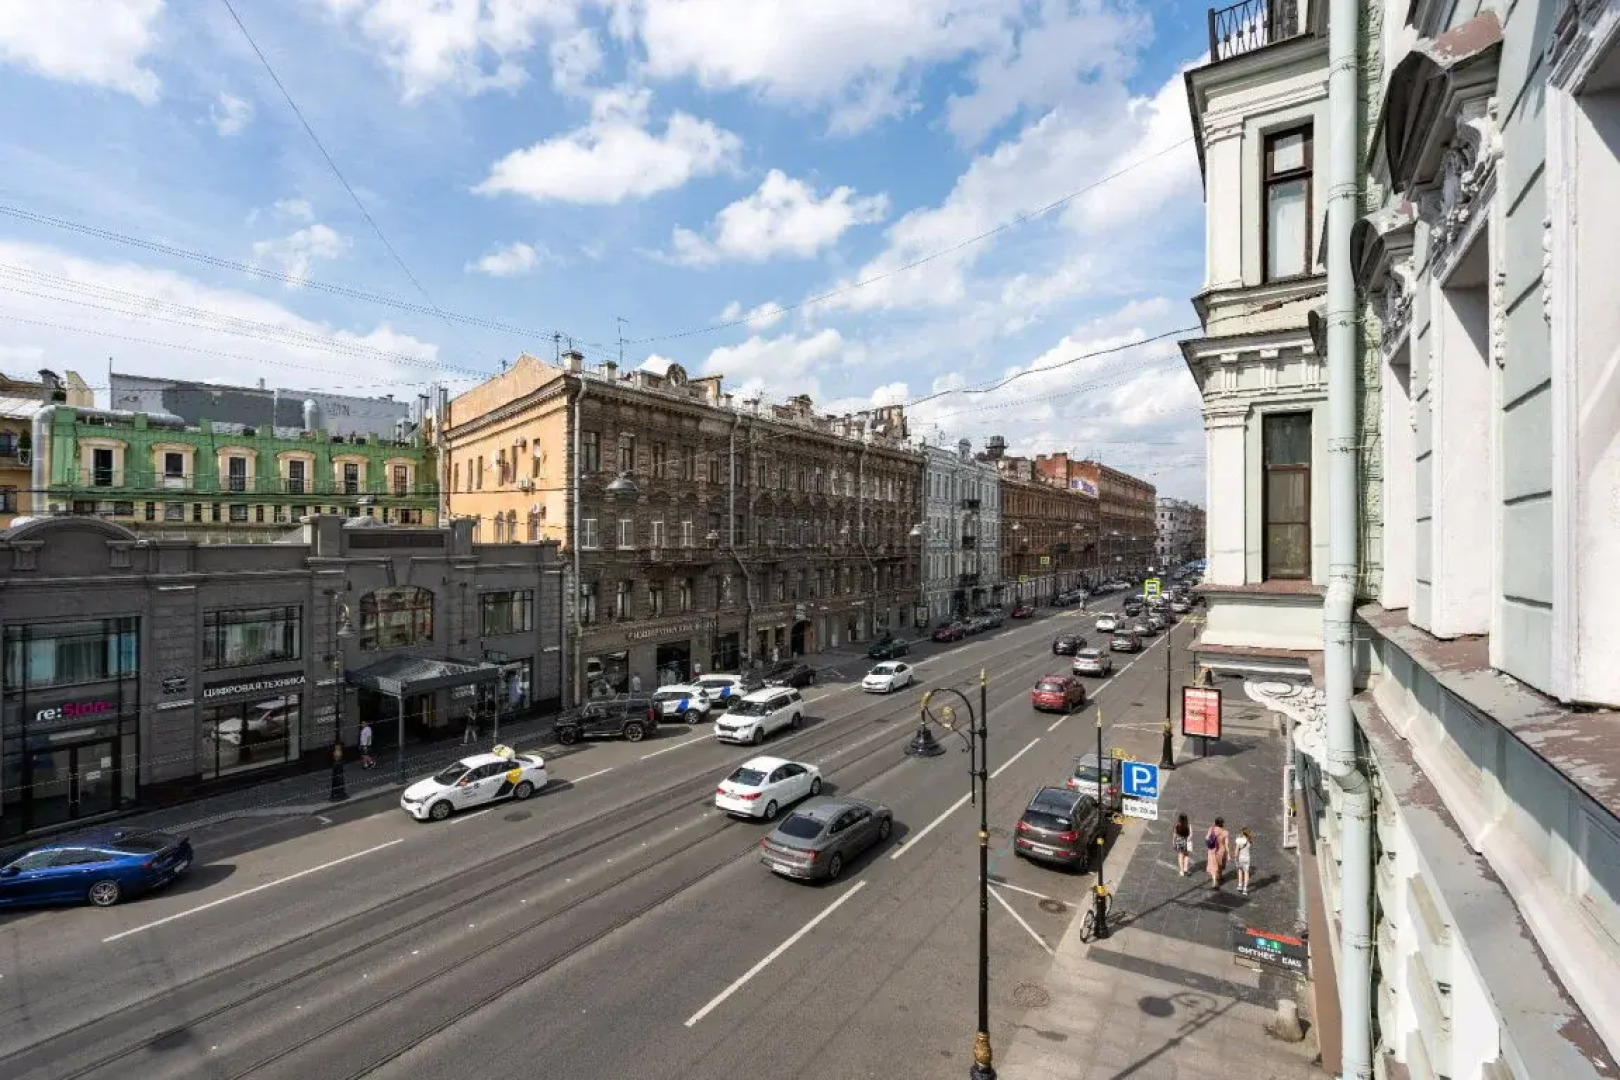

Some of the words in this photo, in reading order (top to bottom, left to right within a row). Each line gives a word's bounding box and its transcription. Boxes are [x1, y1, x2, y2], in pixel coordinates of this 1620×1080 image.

[203, 683, 262, 698] ЦИФРОВАЯ
[263, 675, 306, 690] ТЕХНИКА
[1131, 765, 1151, 792] P
[1238, 945, 1276, 961] ФИТНЕС
[1282, 957, 1302, 968] EMS
